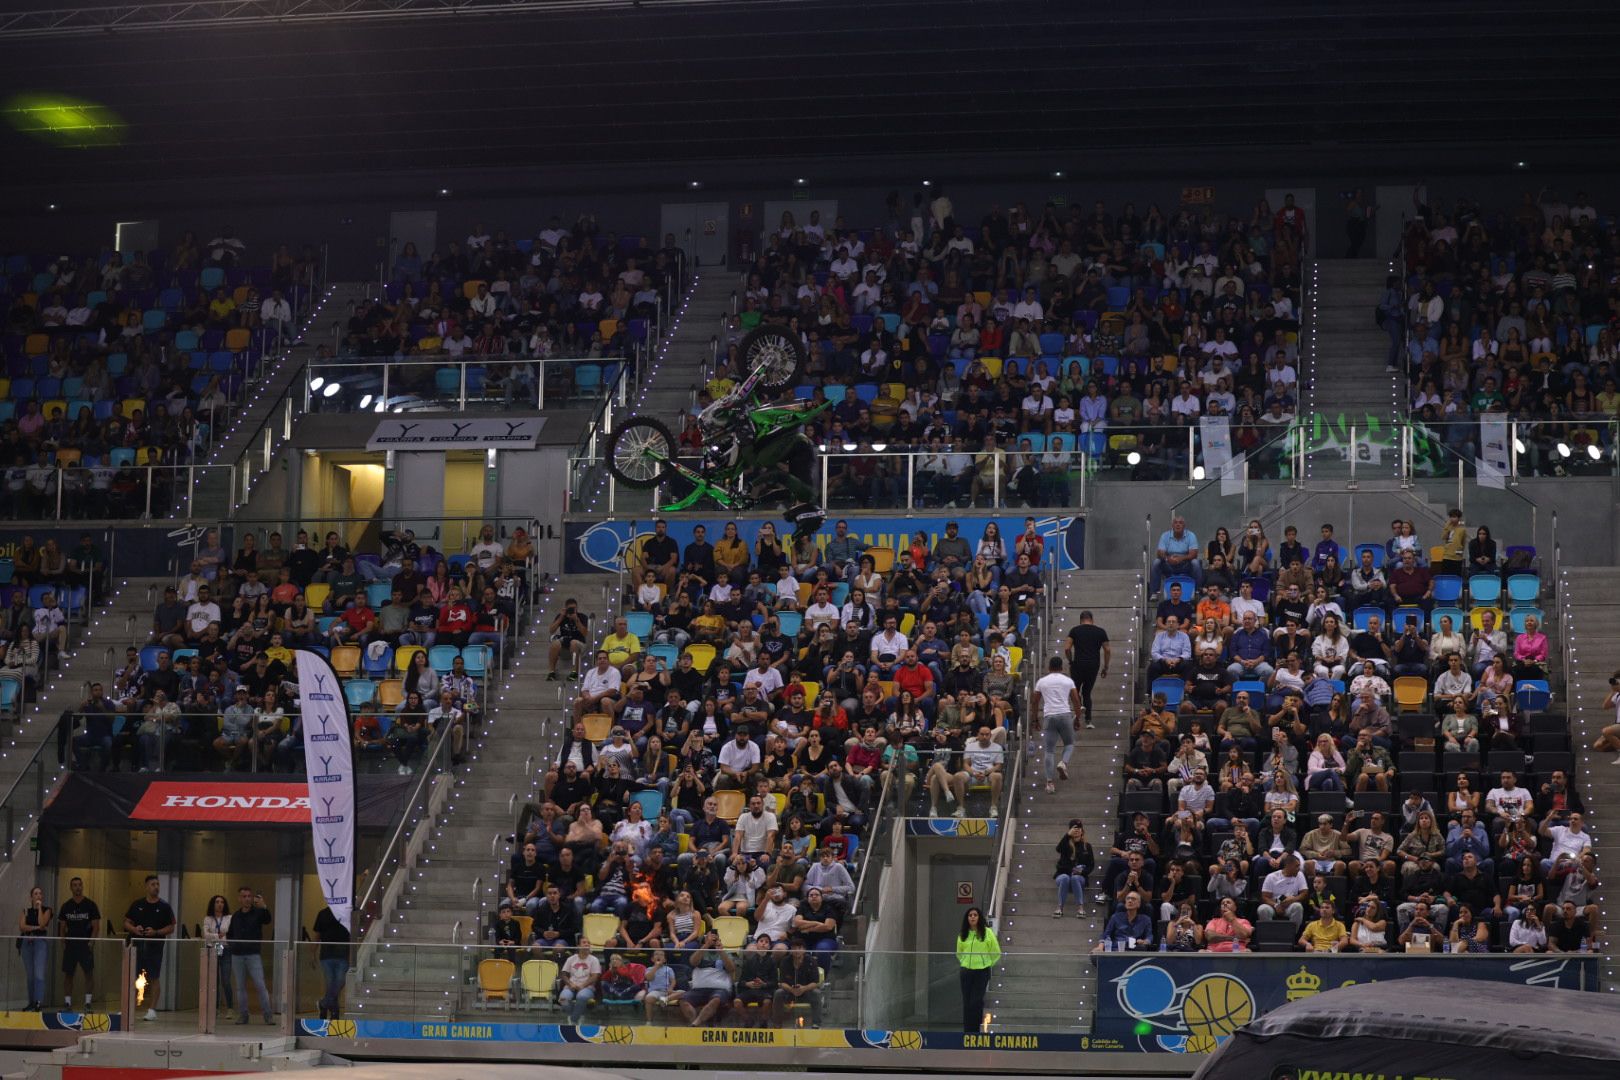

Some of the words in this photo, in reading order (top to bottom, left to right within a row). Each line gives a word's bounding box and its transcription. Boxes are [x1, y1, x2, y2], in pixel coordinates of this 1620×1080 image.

[161, 796, 311, 809] HONDA
[422, 1025, 447, 1037] GRAN
[451, 1025, 492, 1038] CANARIA
[702, 1031, 728, 1043] GRAN
[732, 1031, 774, 1043] CANARIA
[963, 1034, 991, 1048] GRAN
[994, 1035, 1039, 1048] CANARIA
